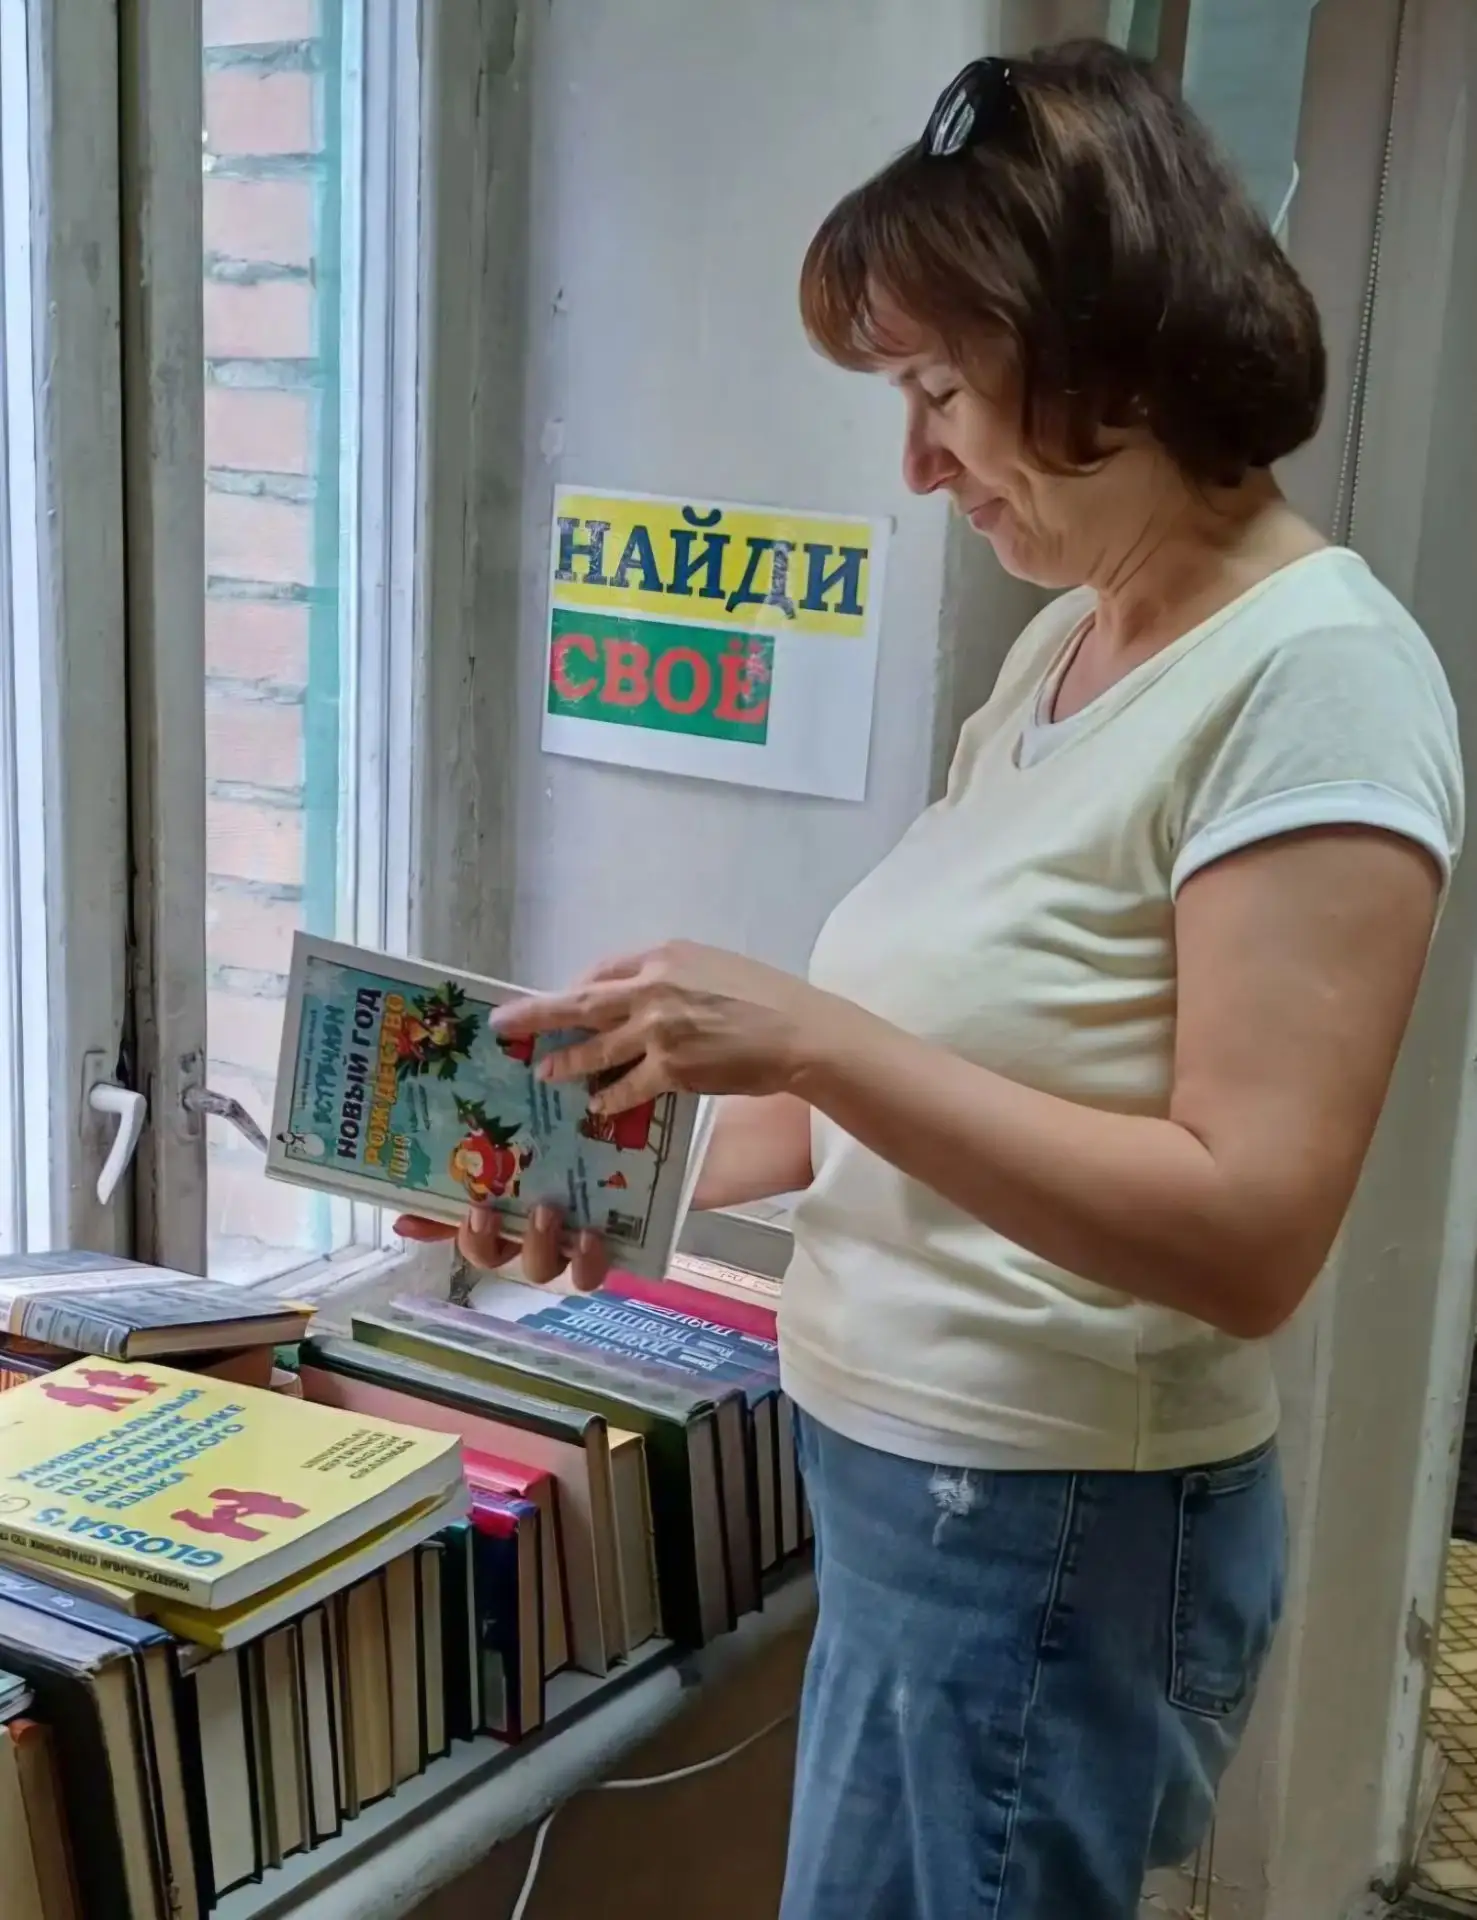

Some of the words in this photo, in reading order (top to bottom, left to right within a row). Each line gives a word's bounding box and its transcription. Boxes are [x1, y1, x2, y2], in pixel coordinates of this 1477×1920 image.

[554, 505, 868, 620] НАЙДИ
[551, 633, 771, 724] СВОЁ
[352, 987, 382, 1047] ГОД
[337, 1053, 369, 1160] НОВЫЙ
[364, 992, 405, 1168] РОЖДЕСТВО
[7, 1388, 206, 1482] УНИВЕРСАЛЬНЫЙ
[33, 1415, 191, 1489] СПРАВОЧНИК
[55, 1477, 98, 1497] ПО
[98, 1403, 247, 1477] ГРАММАТИКЕ
[82, 1423, 245, 1503] АНГЛИЙСКОГО
[105, 1471, 193, 1510] ЯЗЫКА
